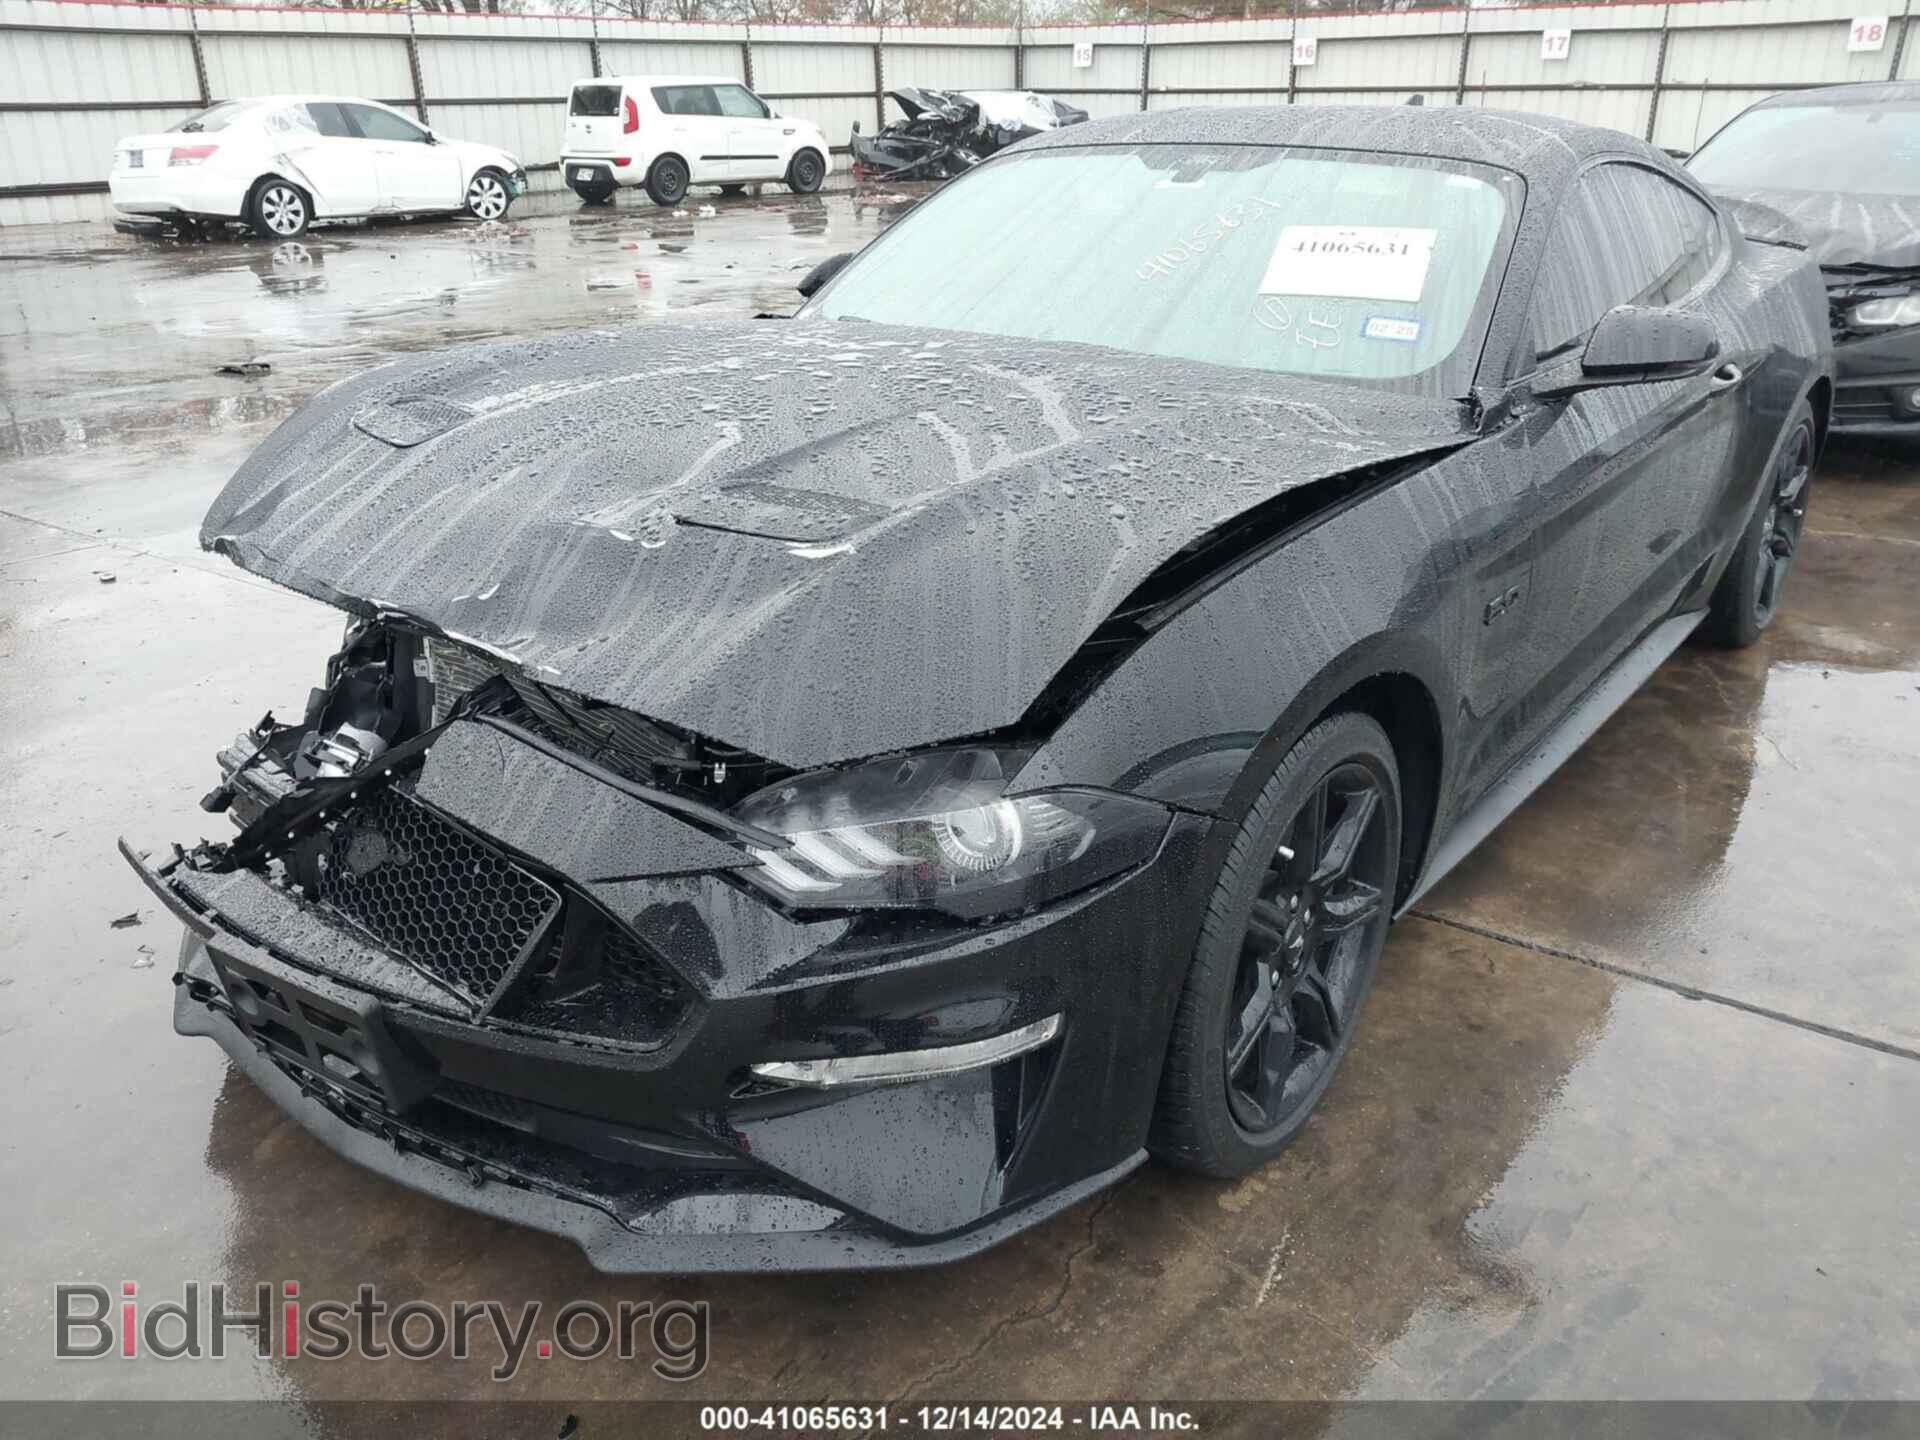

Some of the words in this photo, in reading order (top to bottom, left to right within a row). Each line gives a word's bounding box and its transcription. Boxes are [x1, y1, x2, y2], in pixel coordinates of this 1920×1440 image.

[1856, 24, 1882, 42] 18
[1545, 36, 1568, 51] 17
[1077, 48, 1090, 61] 15
[1296, 45, 1313, 58] 16
[1292, 241, 1409, 256] 41065631
